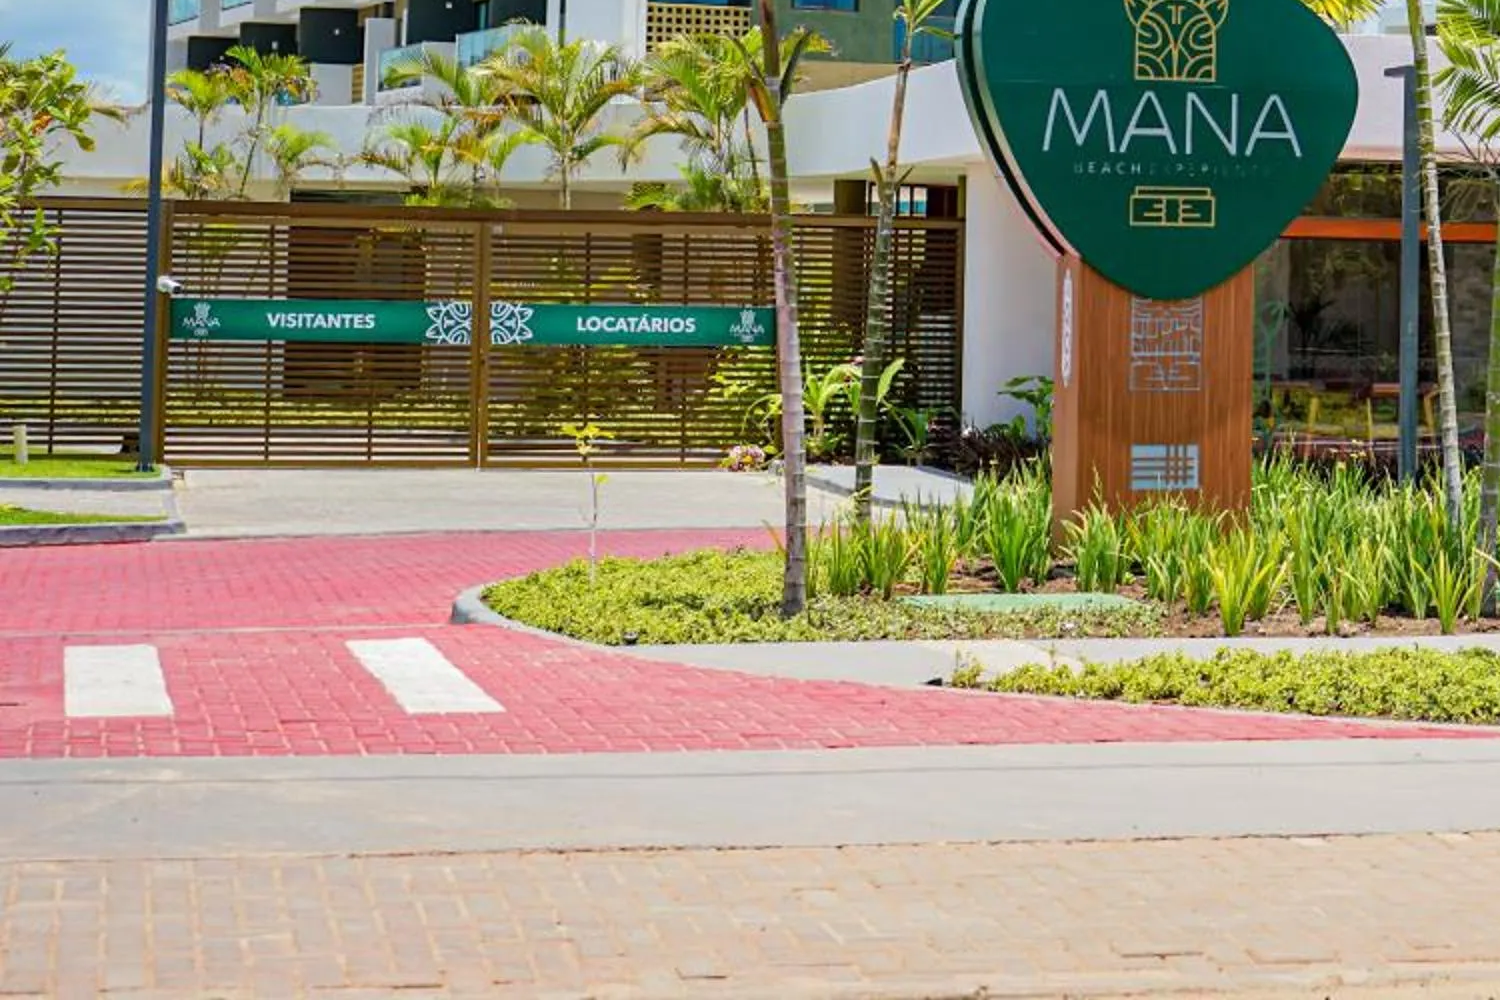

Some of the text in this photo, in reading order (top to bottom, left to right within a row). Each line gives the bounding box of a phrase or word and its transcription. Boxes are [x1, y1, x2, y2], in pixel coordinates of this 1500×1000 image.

[1042, 87, 1302, 158] MANA
[1073, 161, 1141, 175] BEACH
[267, 312, 375, 329] VISITANTES
[577, 314, 696, 333] LOCATÁRIOS
